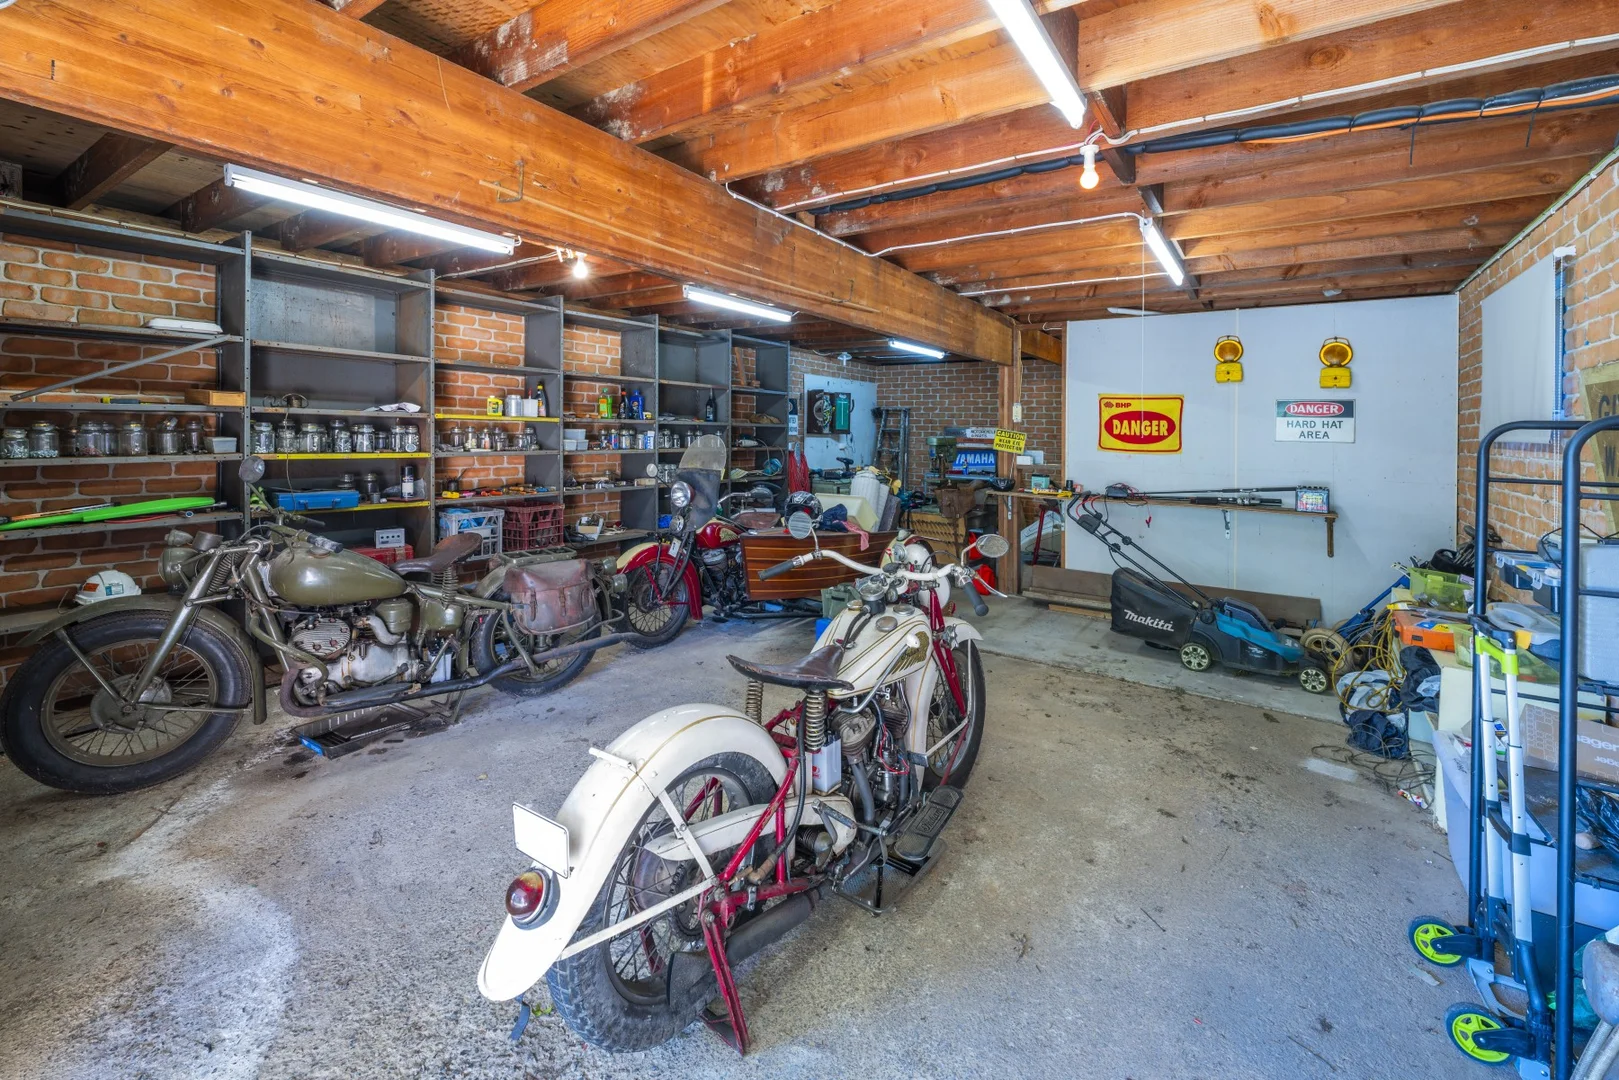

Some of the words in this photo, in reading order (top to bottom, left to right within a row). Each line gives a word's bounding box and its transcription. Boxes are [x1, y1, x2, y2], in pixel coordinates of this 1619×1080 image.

[1290, 403, 1339, 415] DANGER
[1599, 394, 1619, 419] GI
[1112, 419, 1169, 437] DANGER
[1286, 420, 1317, 430] HARD
[1322, 420, 1344, 430] HAT
[997, 430, 1025, 441] CAUTION
[1299, 431, 1330, 440] AREA
[995, 443, 1022, 452] PROTECTION
